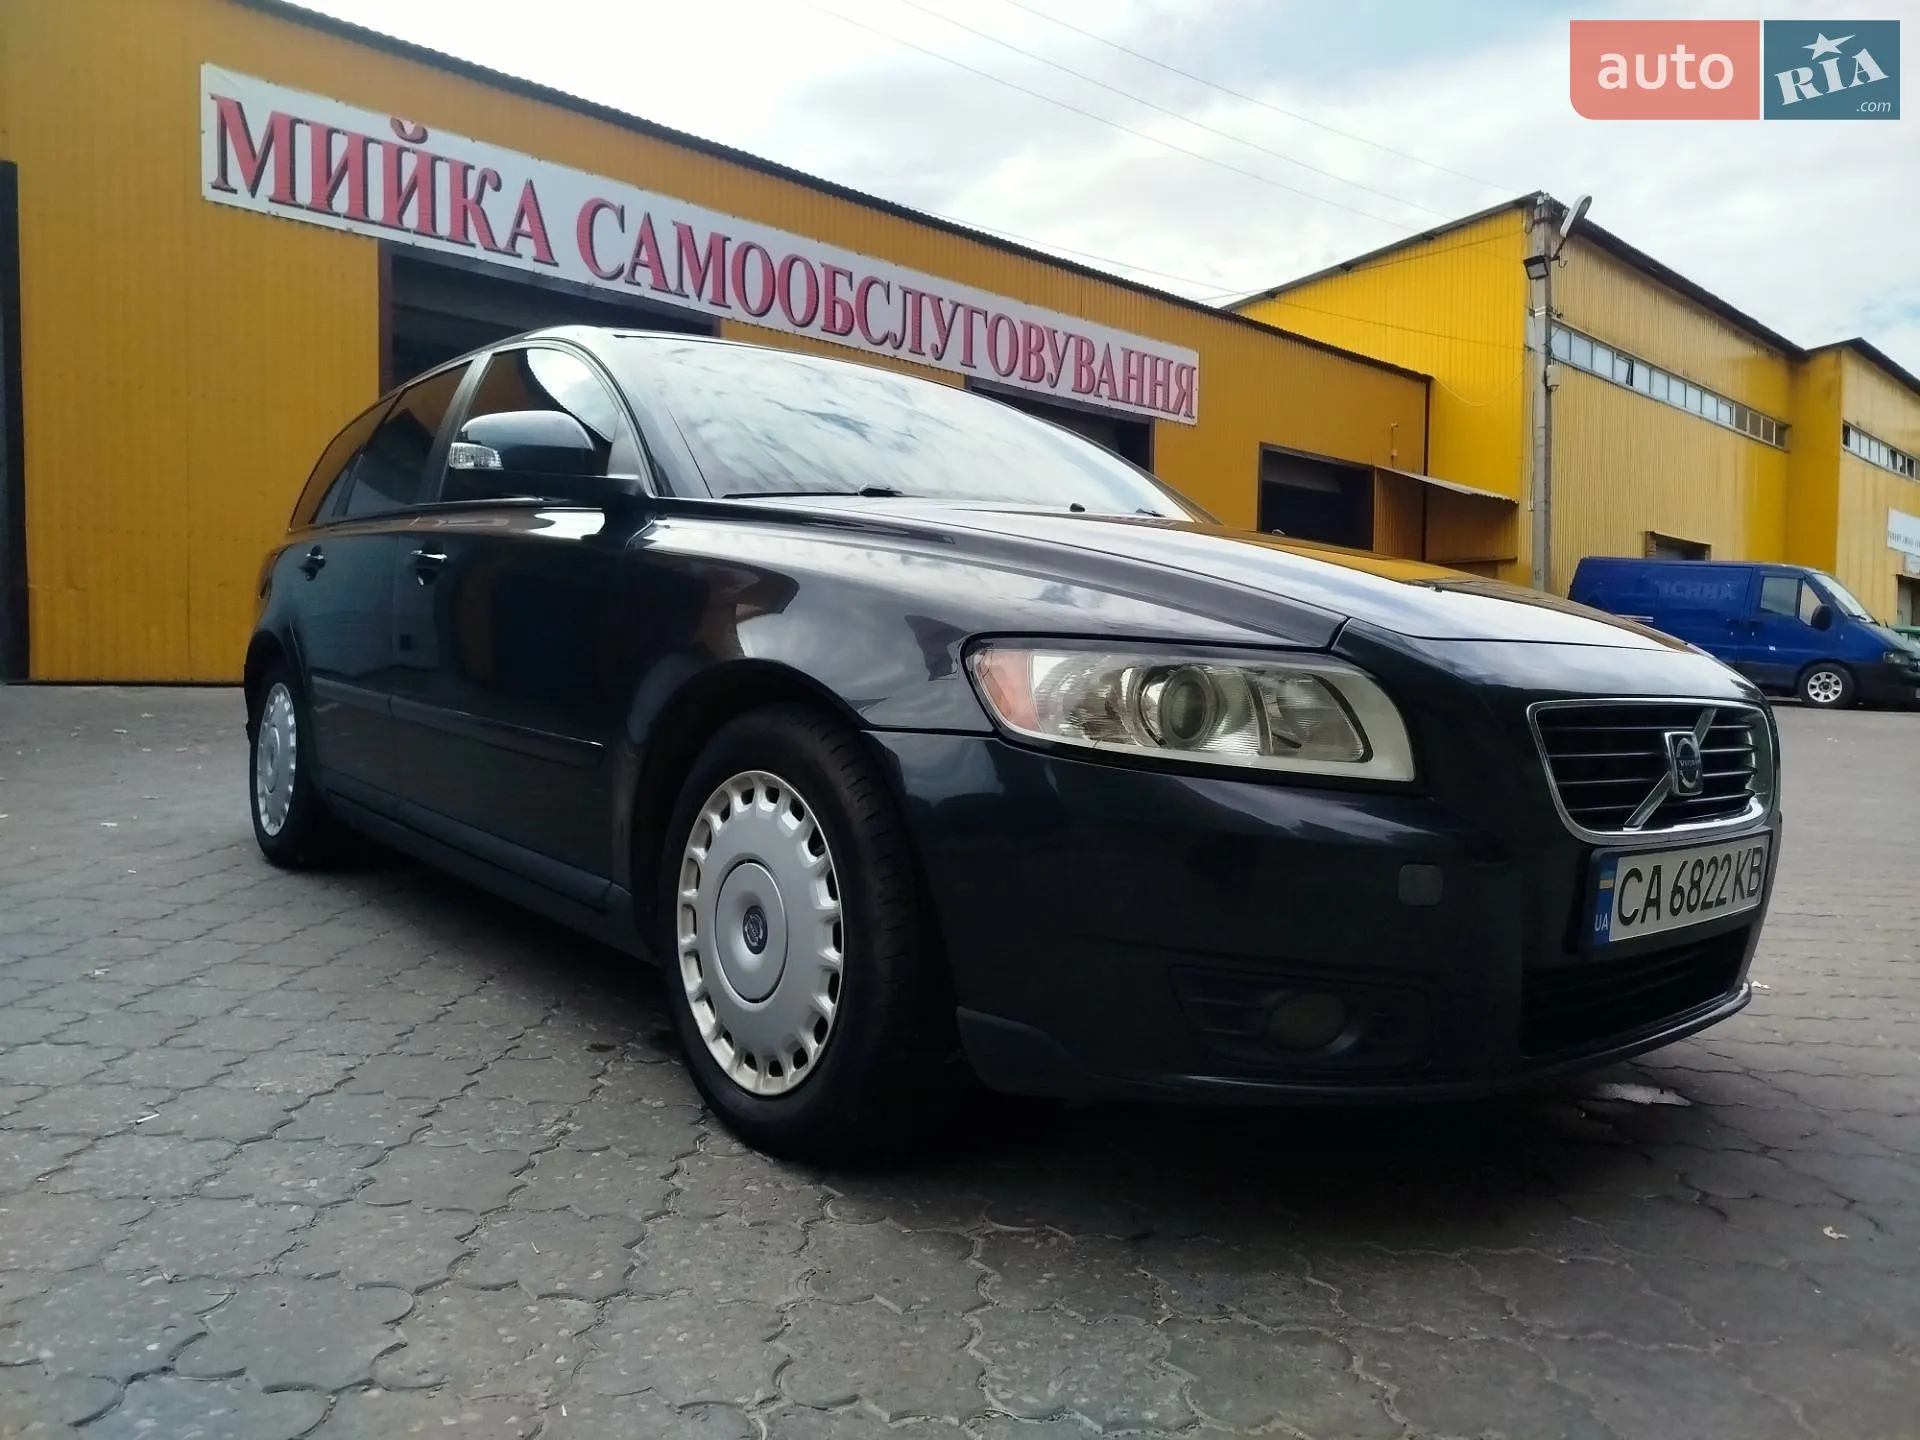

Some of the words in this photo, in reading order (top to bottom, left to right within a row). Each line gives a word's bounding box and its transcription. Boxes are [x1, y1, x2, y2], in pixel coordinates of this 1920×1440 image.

[208, 92, 560, 267] МИЙКА
[575, 196, 1197, 420] САМООБСЛУГОВУВАННЯ
[1594, 914, 1610, 932] UA
